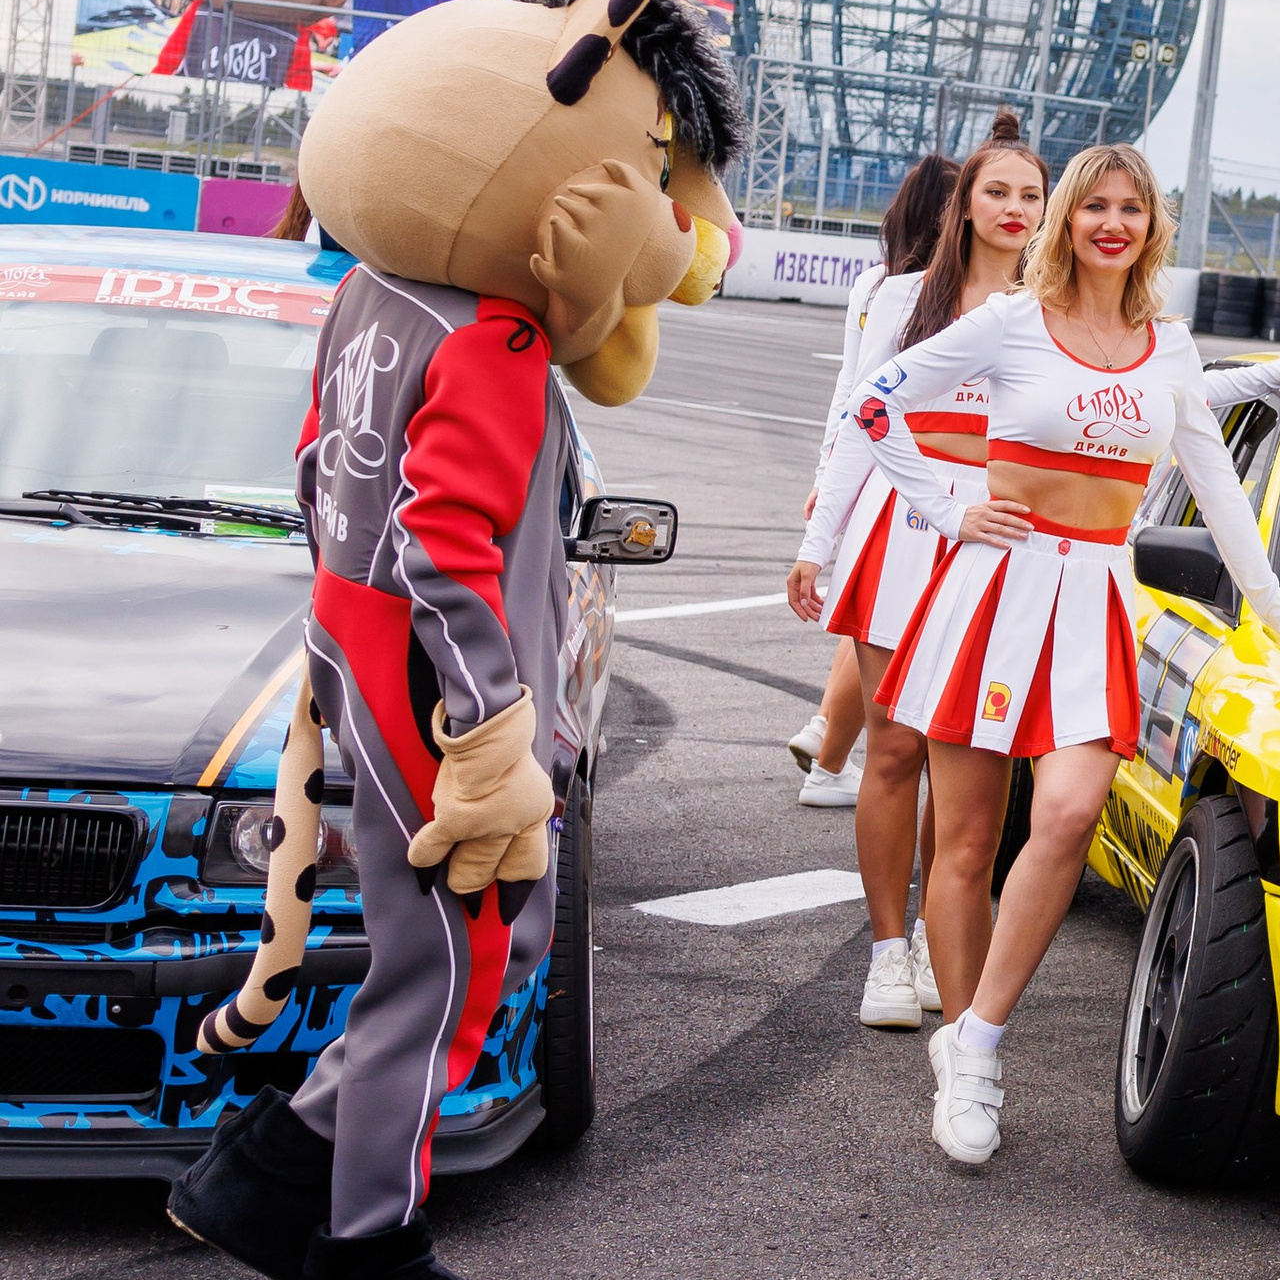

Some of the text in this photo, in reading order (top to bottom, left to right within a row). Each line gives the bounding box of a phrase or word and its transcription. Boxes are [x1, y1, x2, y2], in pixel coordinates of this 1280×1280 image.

[51, 188, 150, 213] НОРНИКЕЛЬ
[774, 251, 864, 287] ИЗВЕСТИЯ
[0, 290, 36, 298] РАЙВ
[97, 272, 285, 311] IDDC
[95, 295, 280, 319] DRIFT CHALLENGE
[1073, 441, 1128, 457] ДРАЙВ
